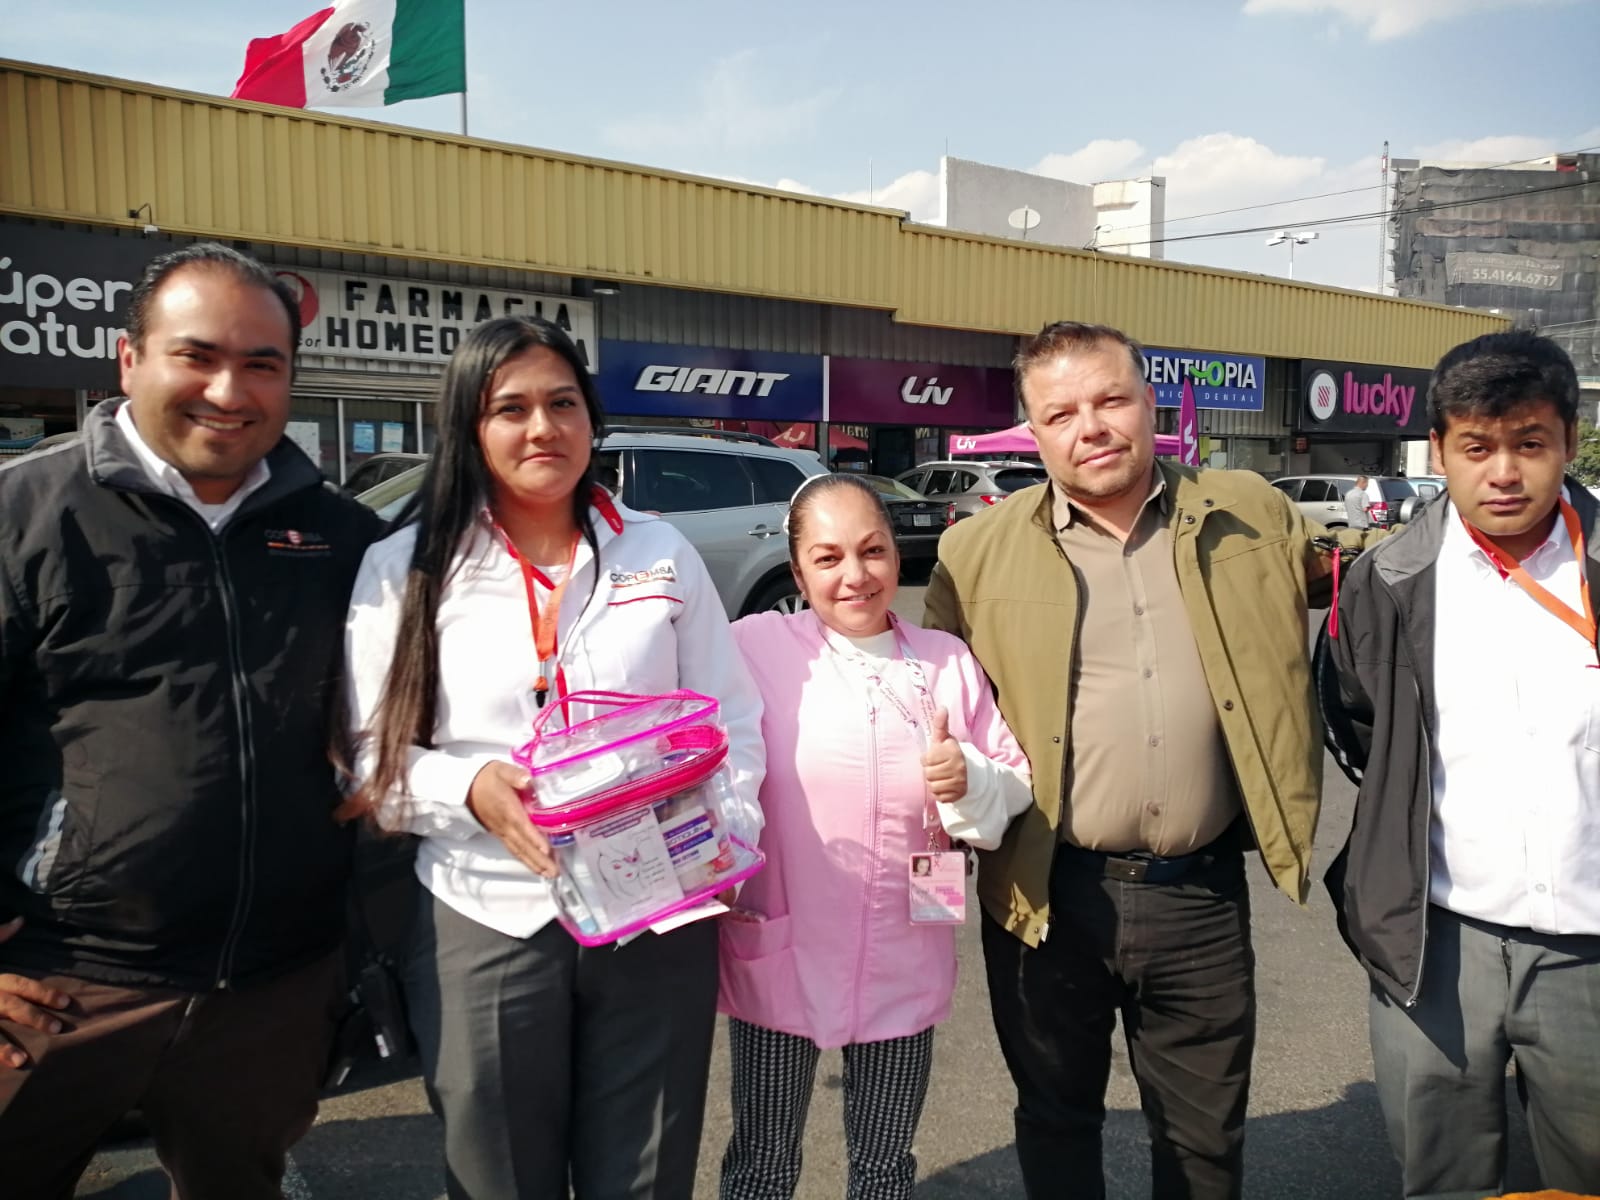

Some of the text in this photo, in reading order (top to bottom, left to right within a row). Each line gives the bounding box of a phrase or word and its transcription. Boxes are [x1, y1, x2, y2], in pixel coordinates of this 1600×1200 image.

[634, 365, 791, 397] GIANT
[901, 375, 954, 405] Liv
[1204, 392, 1254, 402] DENTAL
[1343, 371, 1415, 426] lucky
[956, 438, 977, 450] Liv
